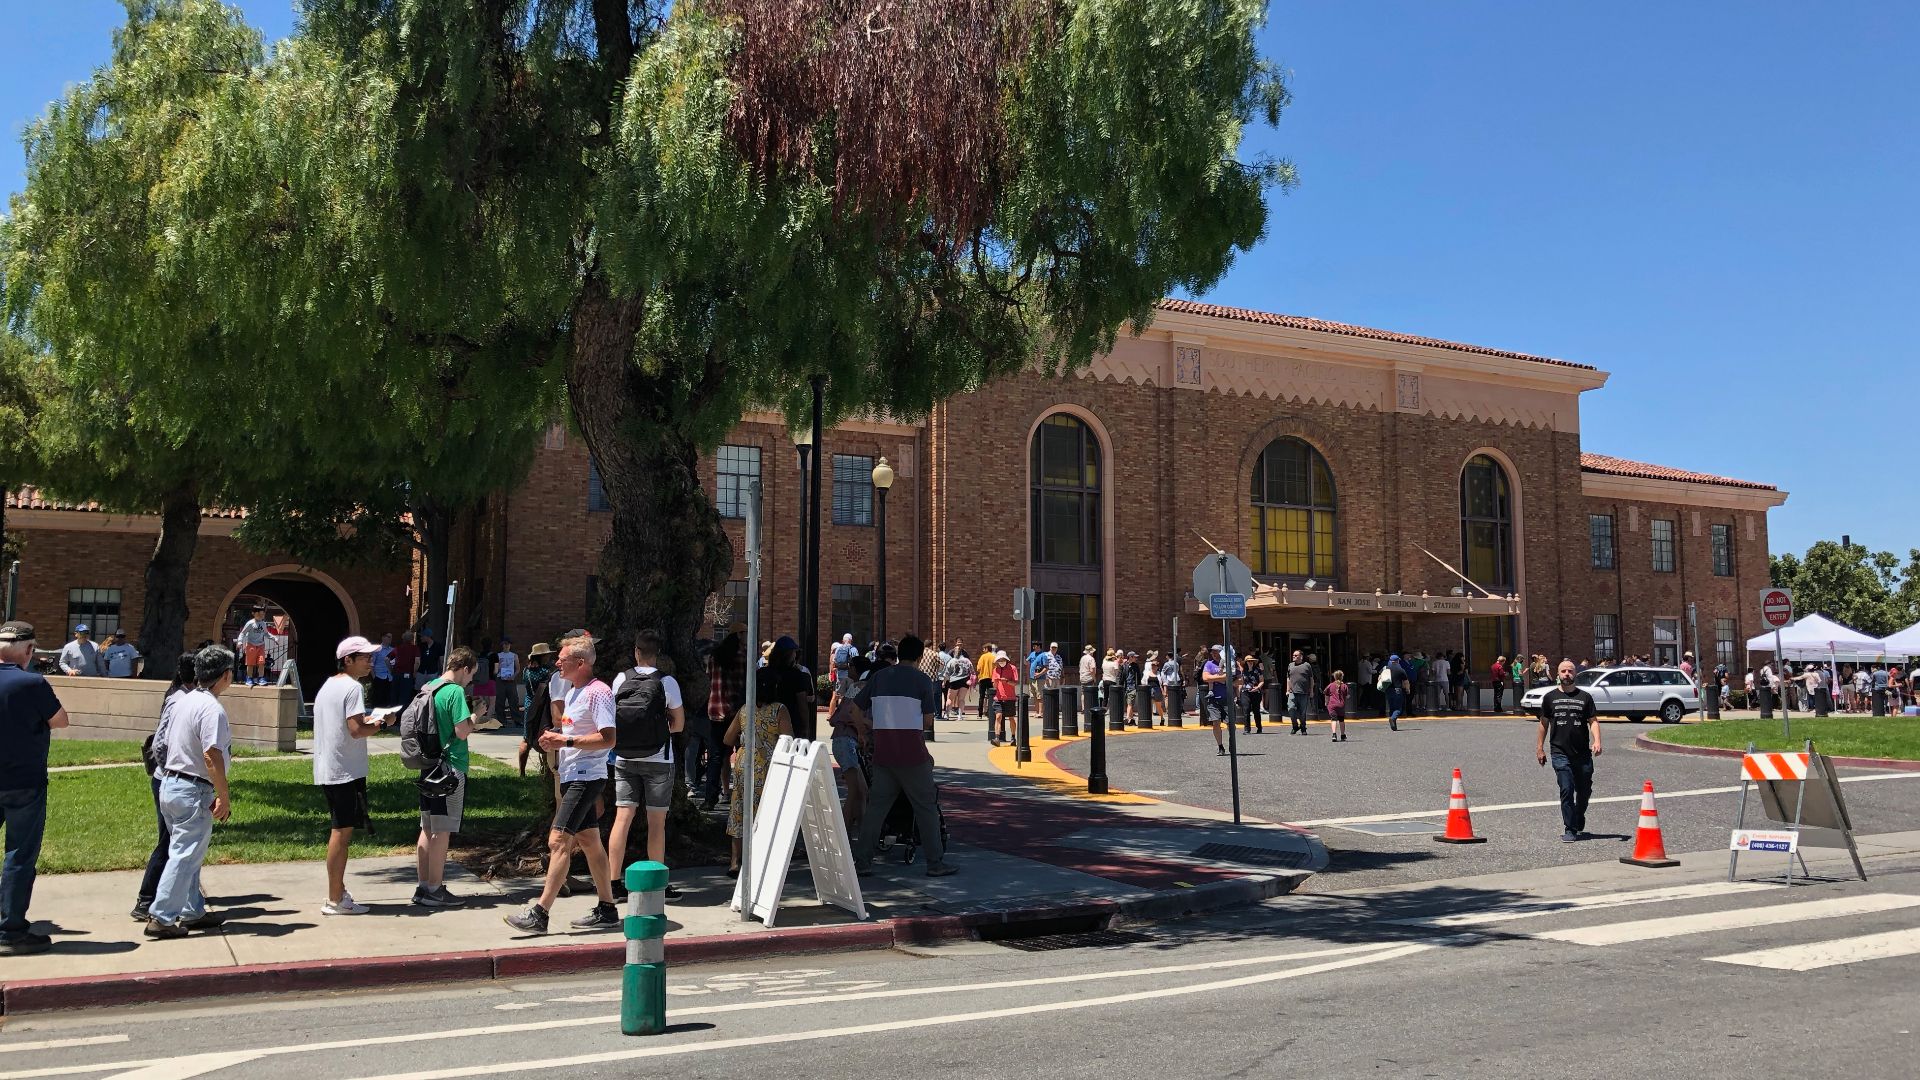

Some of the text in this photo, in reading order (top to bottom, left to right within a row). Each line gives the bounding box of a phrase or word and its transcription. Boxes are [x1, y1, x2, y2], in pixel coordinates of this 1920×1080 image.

[1766, 596, 1787, 605] DO NOT
[1433, 601, 1461, 609] STATION
[1769, 613, 1787, 621] ENTER
